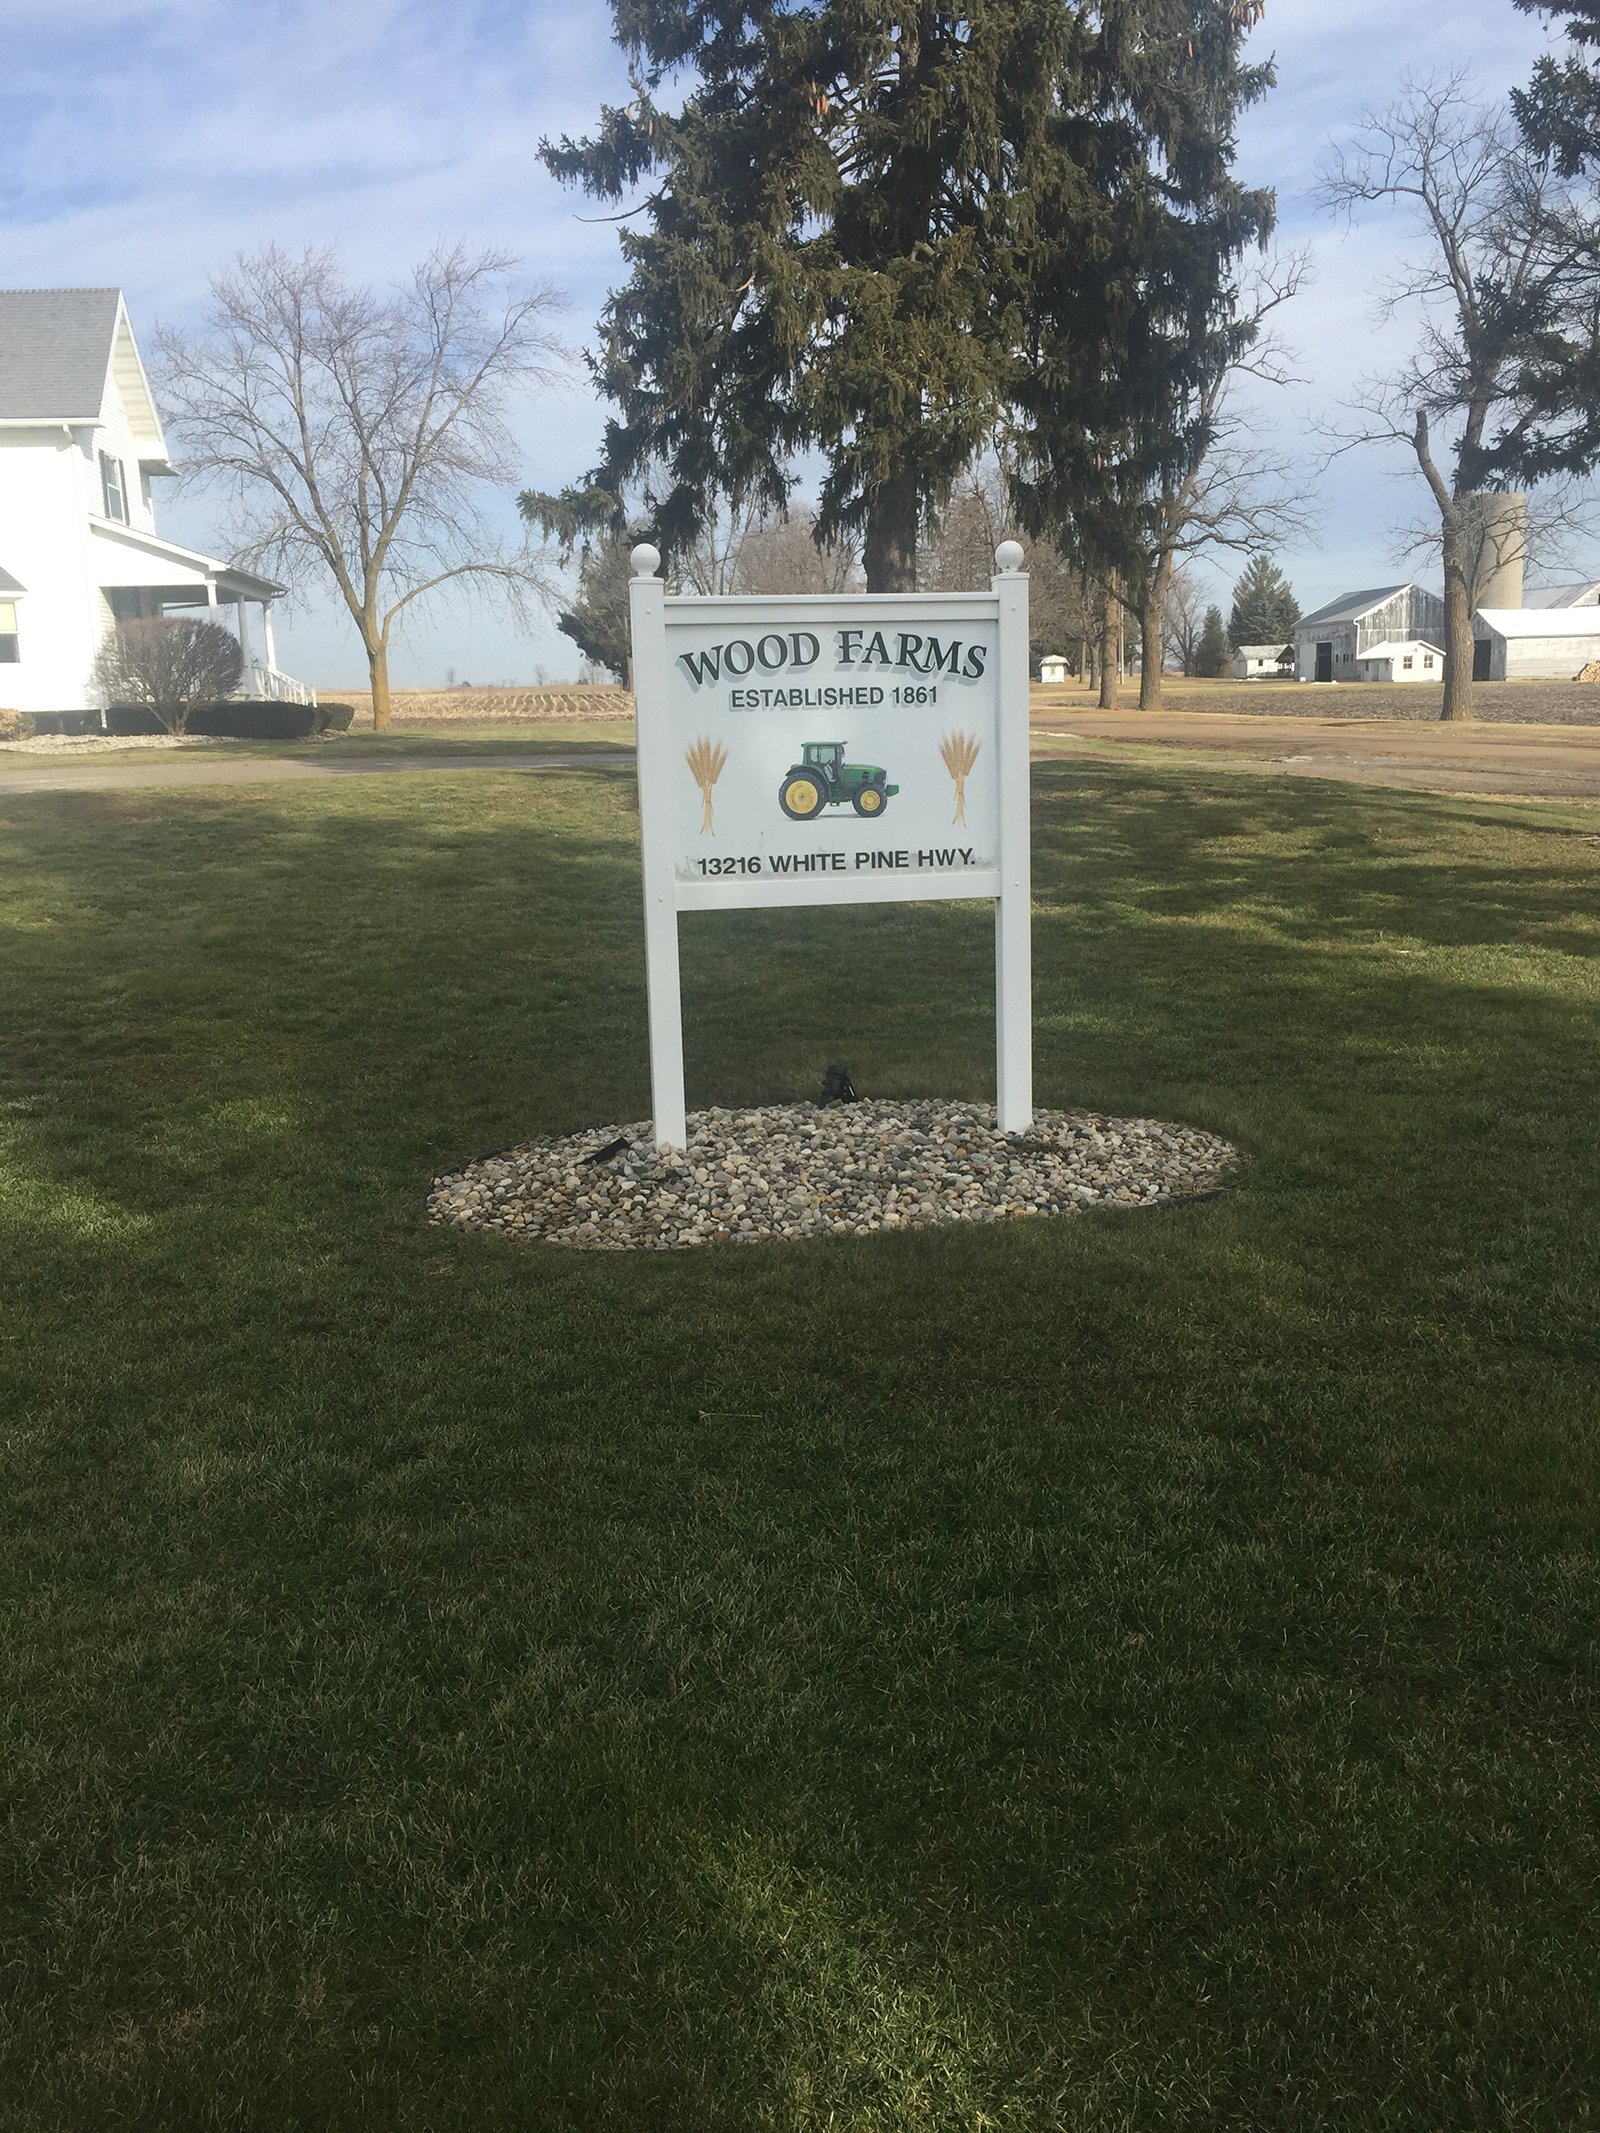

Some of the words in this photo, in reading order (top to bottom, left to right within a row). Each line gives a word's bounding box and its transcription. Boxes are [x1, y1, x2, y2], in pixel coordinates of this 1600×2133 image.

[680, 631, 820, 686] WOOD
[837, 629, 987, 679] FARMS
[731, 687, 884, 708] ESTABLISHED
[892, 686, 938, 704] 1861
[698, 856, 761, 875] 13216
[769, 853, 846, 873] WHITE
[855, 850, 909, 869] PINE
[918, 848, 976, 867] HWY.
